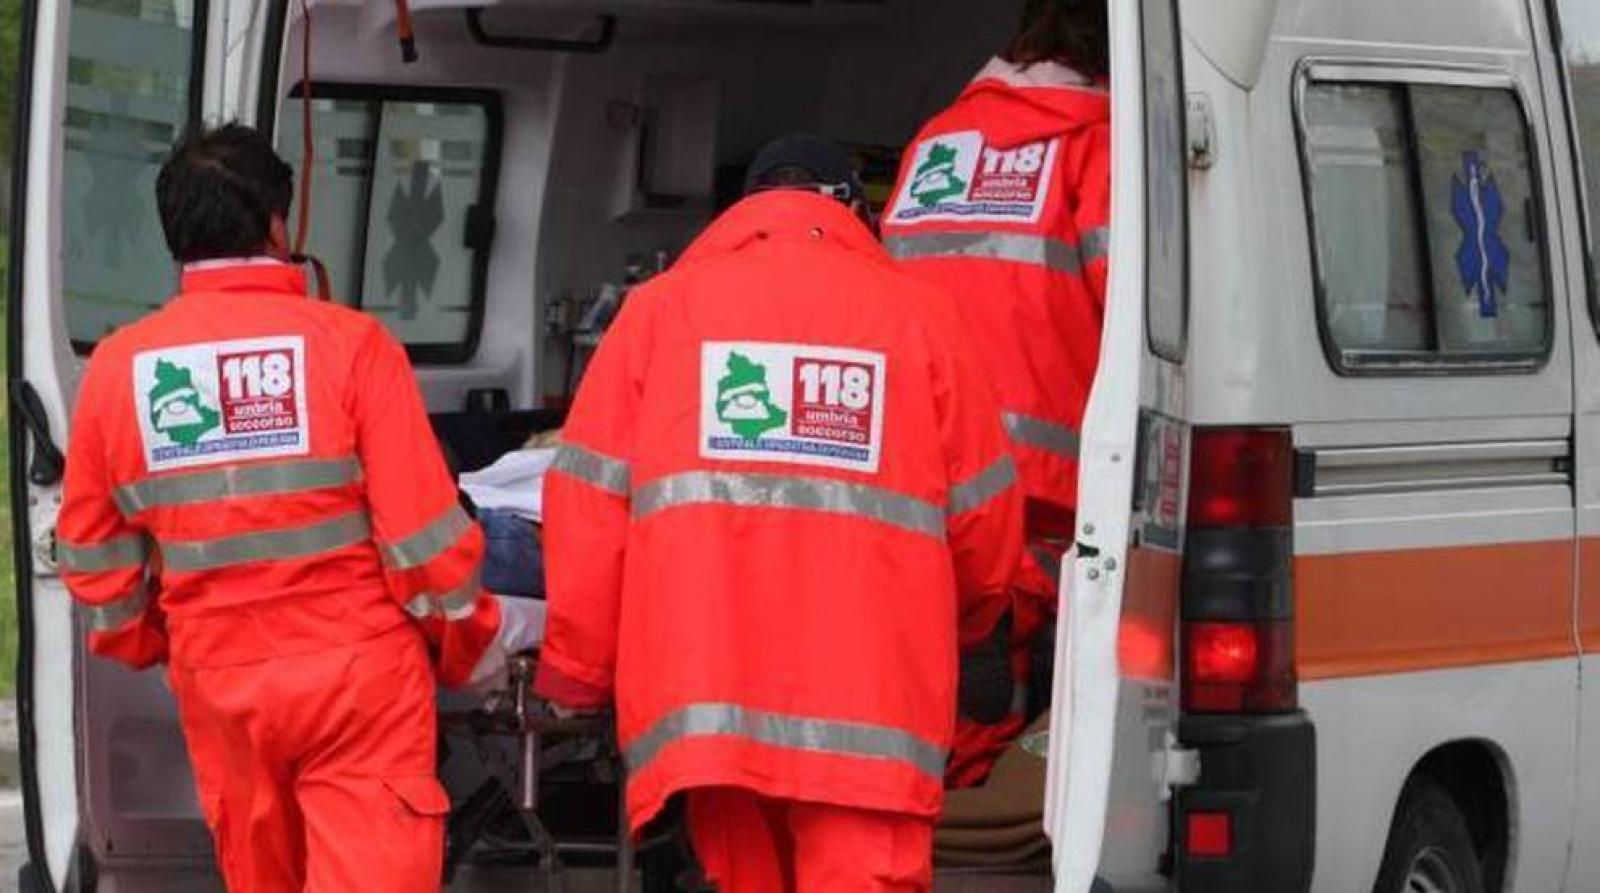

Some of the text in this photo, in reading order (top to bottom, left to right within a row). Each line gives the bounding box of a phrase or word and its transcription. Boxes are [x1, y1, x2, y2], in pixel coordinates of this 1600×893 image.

[983, 142, 1045, 173] 118
[222, 353, 292, 399] 118
[799, 362, 871, 410] 118
[234, 402, 284, 417] umbria
[805, 409, 858, 426] umbria
[797, 424, 866, 441] soccorso
